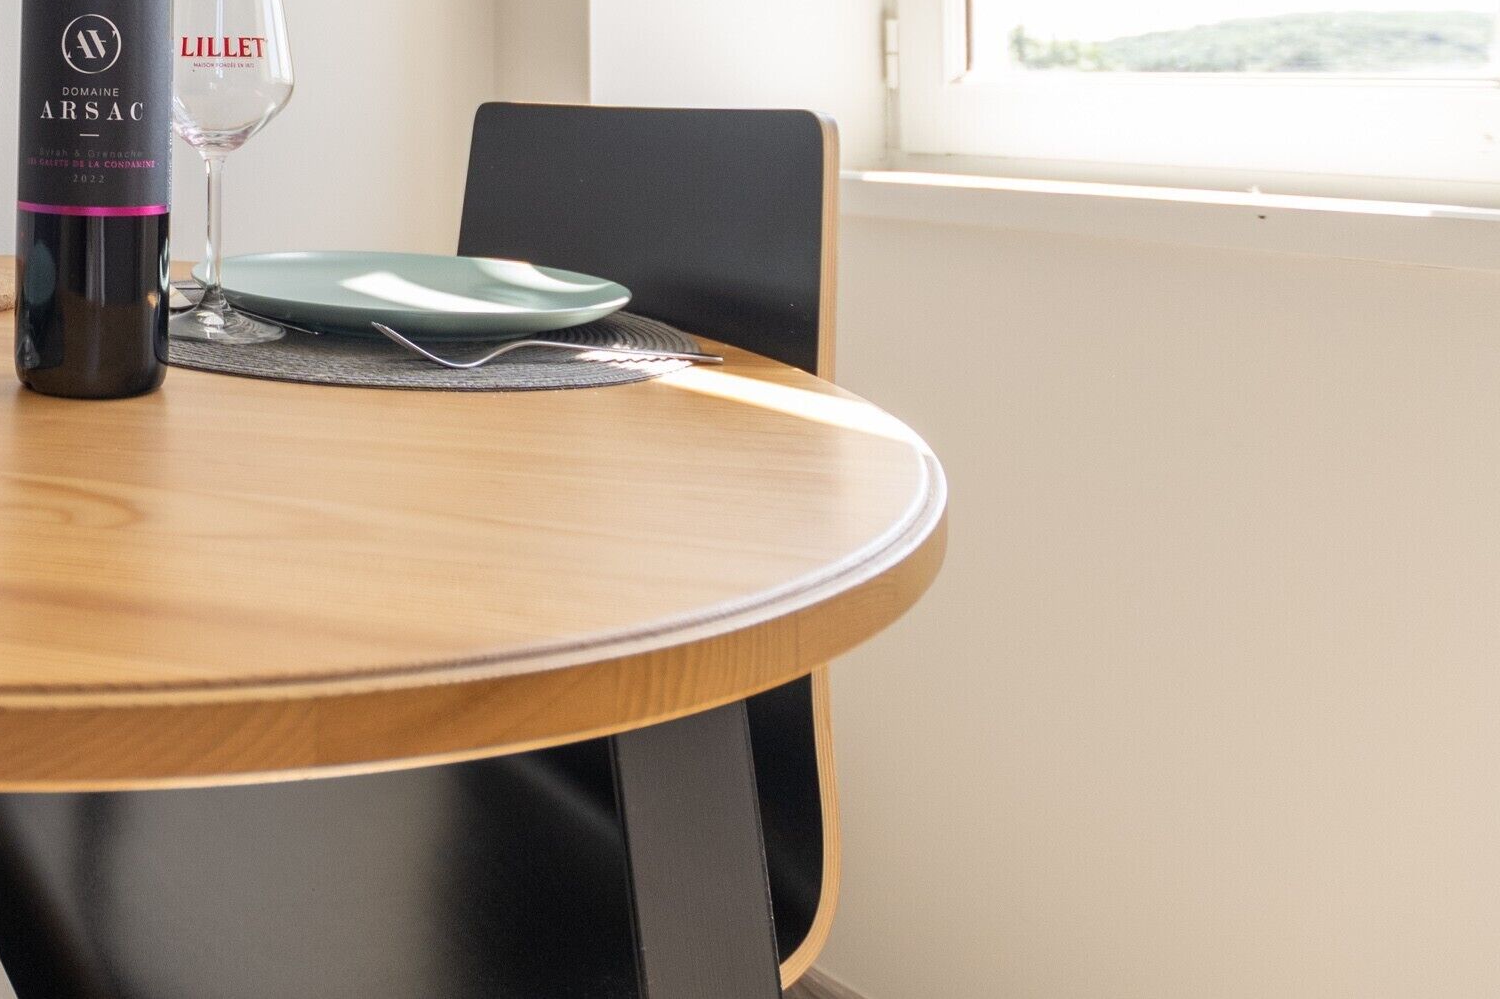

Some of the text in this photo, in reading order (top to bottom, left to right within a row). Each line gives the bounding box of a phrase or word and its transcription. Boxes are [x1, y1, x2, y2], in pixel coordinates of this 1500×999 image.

[181, 37, 264, 58] LILLET
[62, 86, 120, 97] DOMAINE
[40, 100, 144, 122] ARSAC
[88, 160, 100, 169] LA
[104, 160, 156, 169] CONDAMINE
[72, 174, 106, 183] 2022
